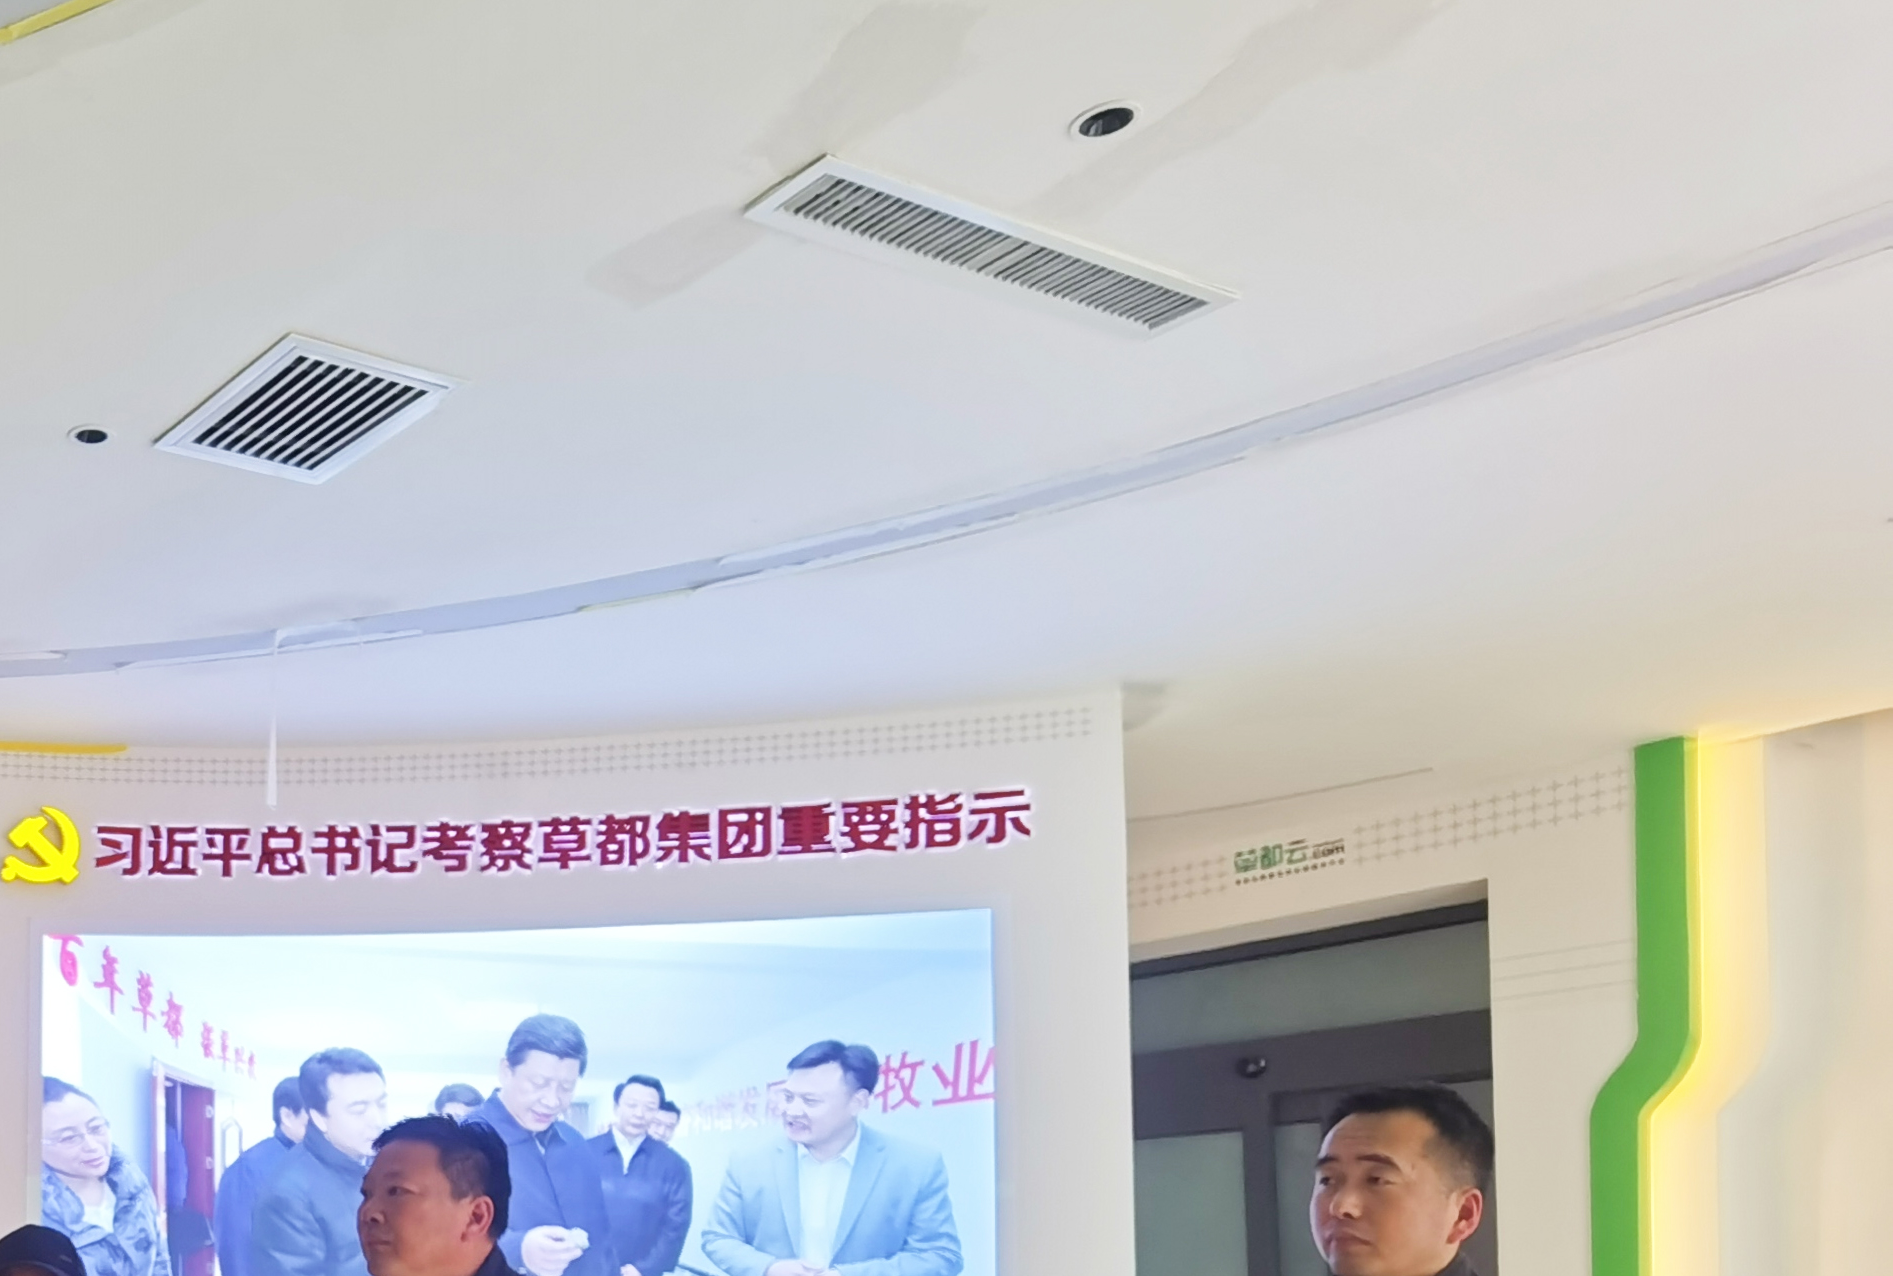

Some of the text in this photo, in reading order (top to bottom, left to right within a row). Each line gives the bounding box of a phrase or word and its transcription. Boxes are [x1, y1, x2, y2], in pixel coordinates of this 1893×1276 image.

[93, 787, 1033, 879] 习近平总书记考察草都集团重要指示
